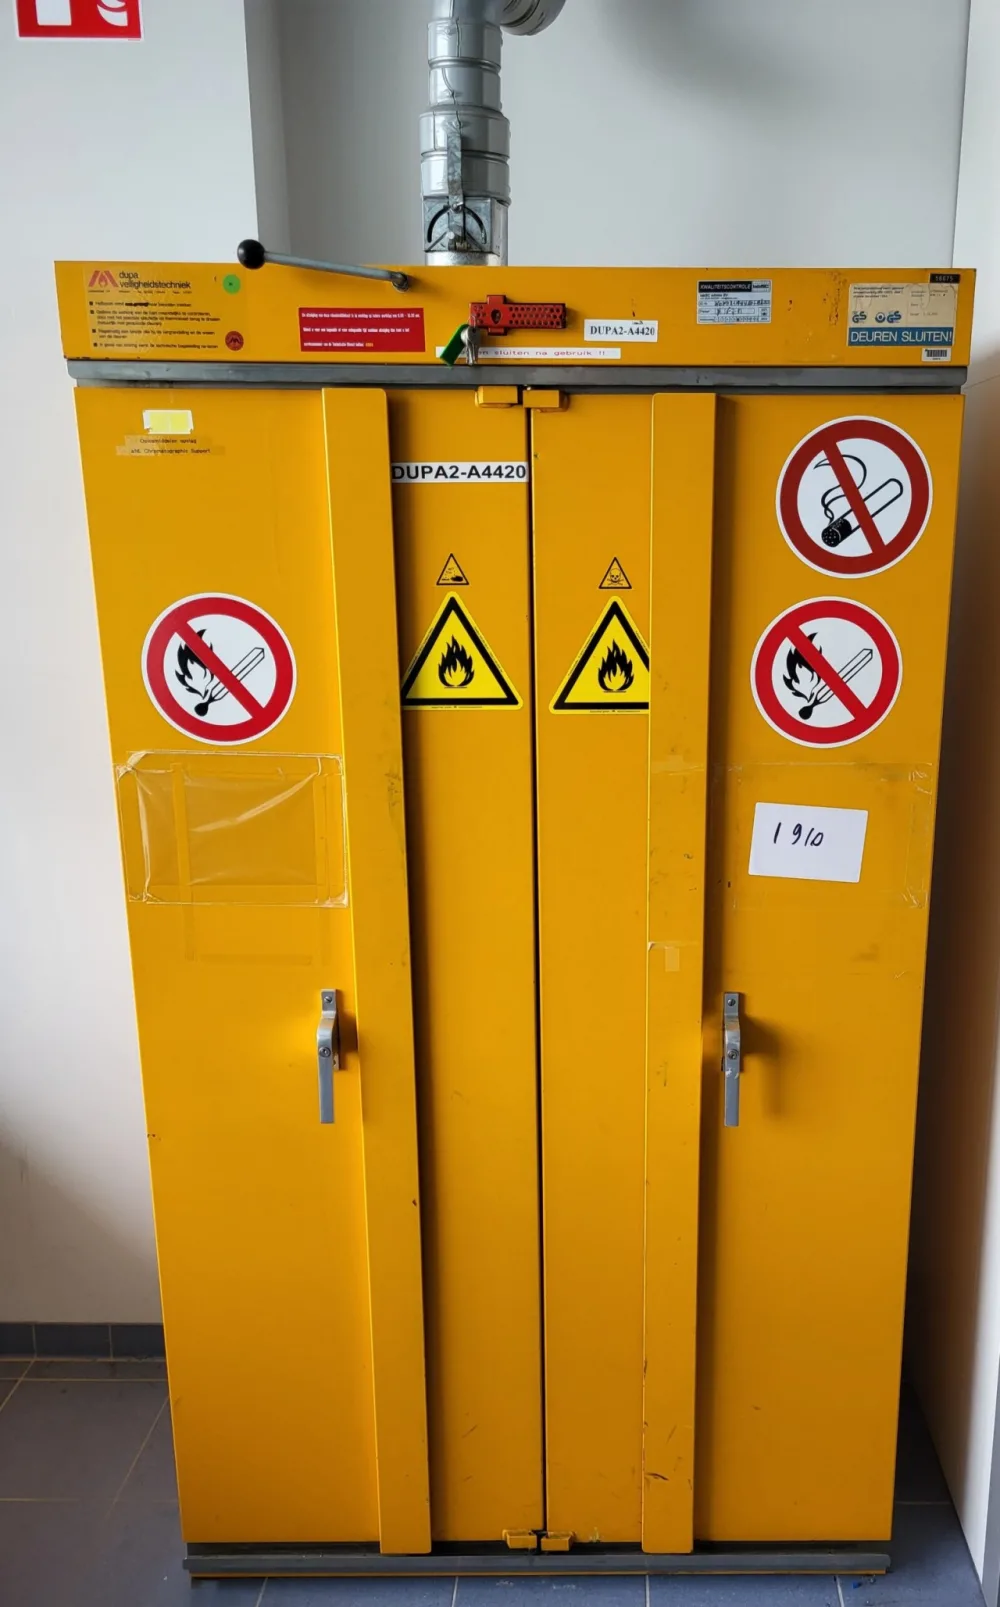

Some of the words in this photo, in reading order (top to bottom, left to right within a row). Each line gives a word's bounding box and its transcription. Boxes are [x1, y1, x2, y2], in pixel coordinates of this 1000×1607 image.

[119, 271, 138, 280] dupa
[120, 281, 191, 289] veiligheidstechniek
[590, 326, 656, 336] DUPA2-A4420
[850, 331, 898, 342] DEUREN
[901, 331, 952, 342] SLUITEN!
[392, 465, 526, 480] DUPA2-A4420
